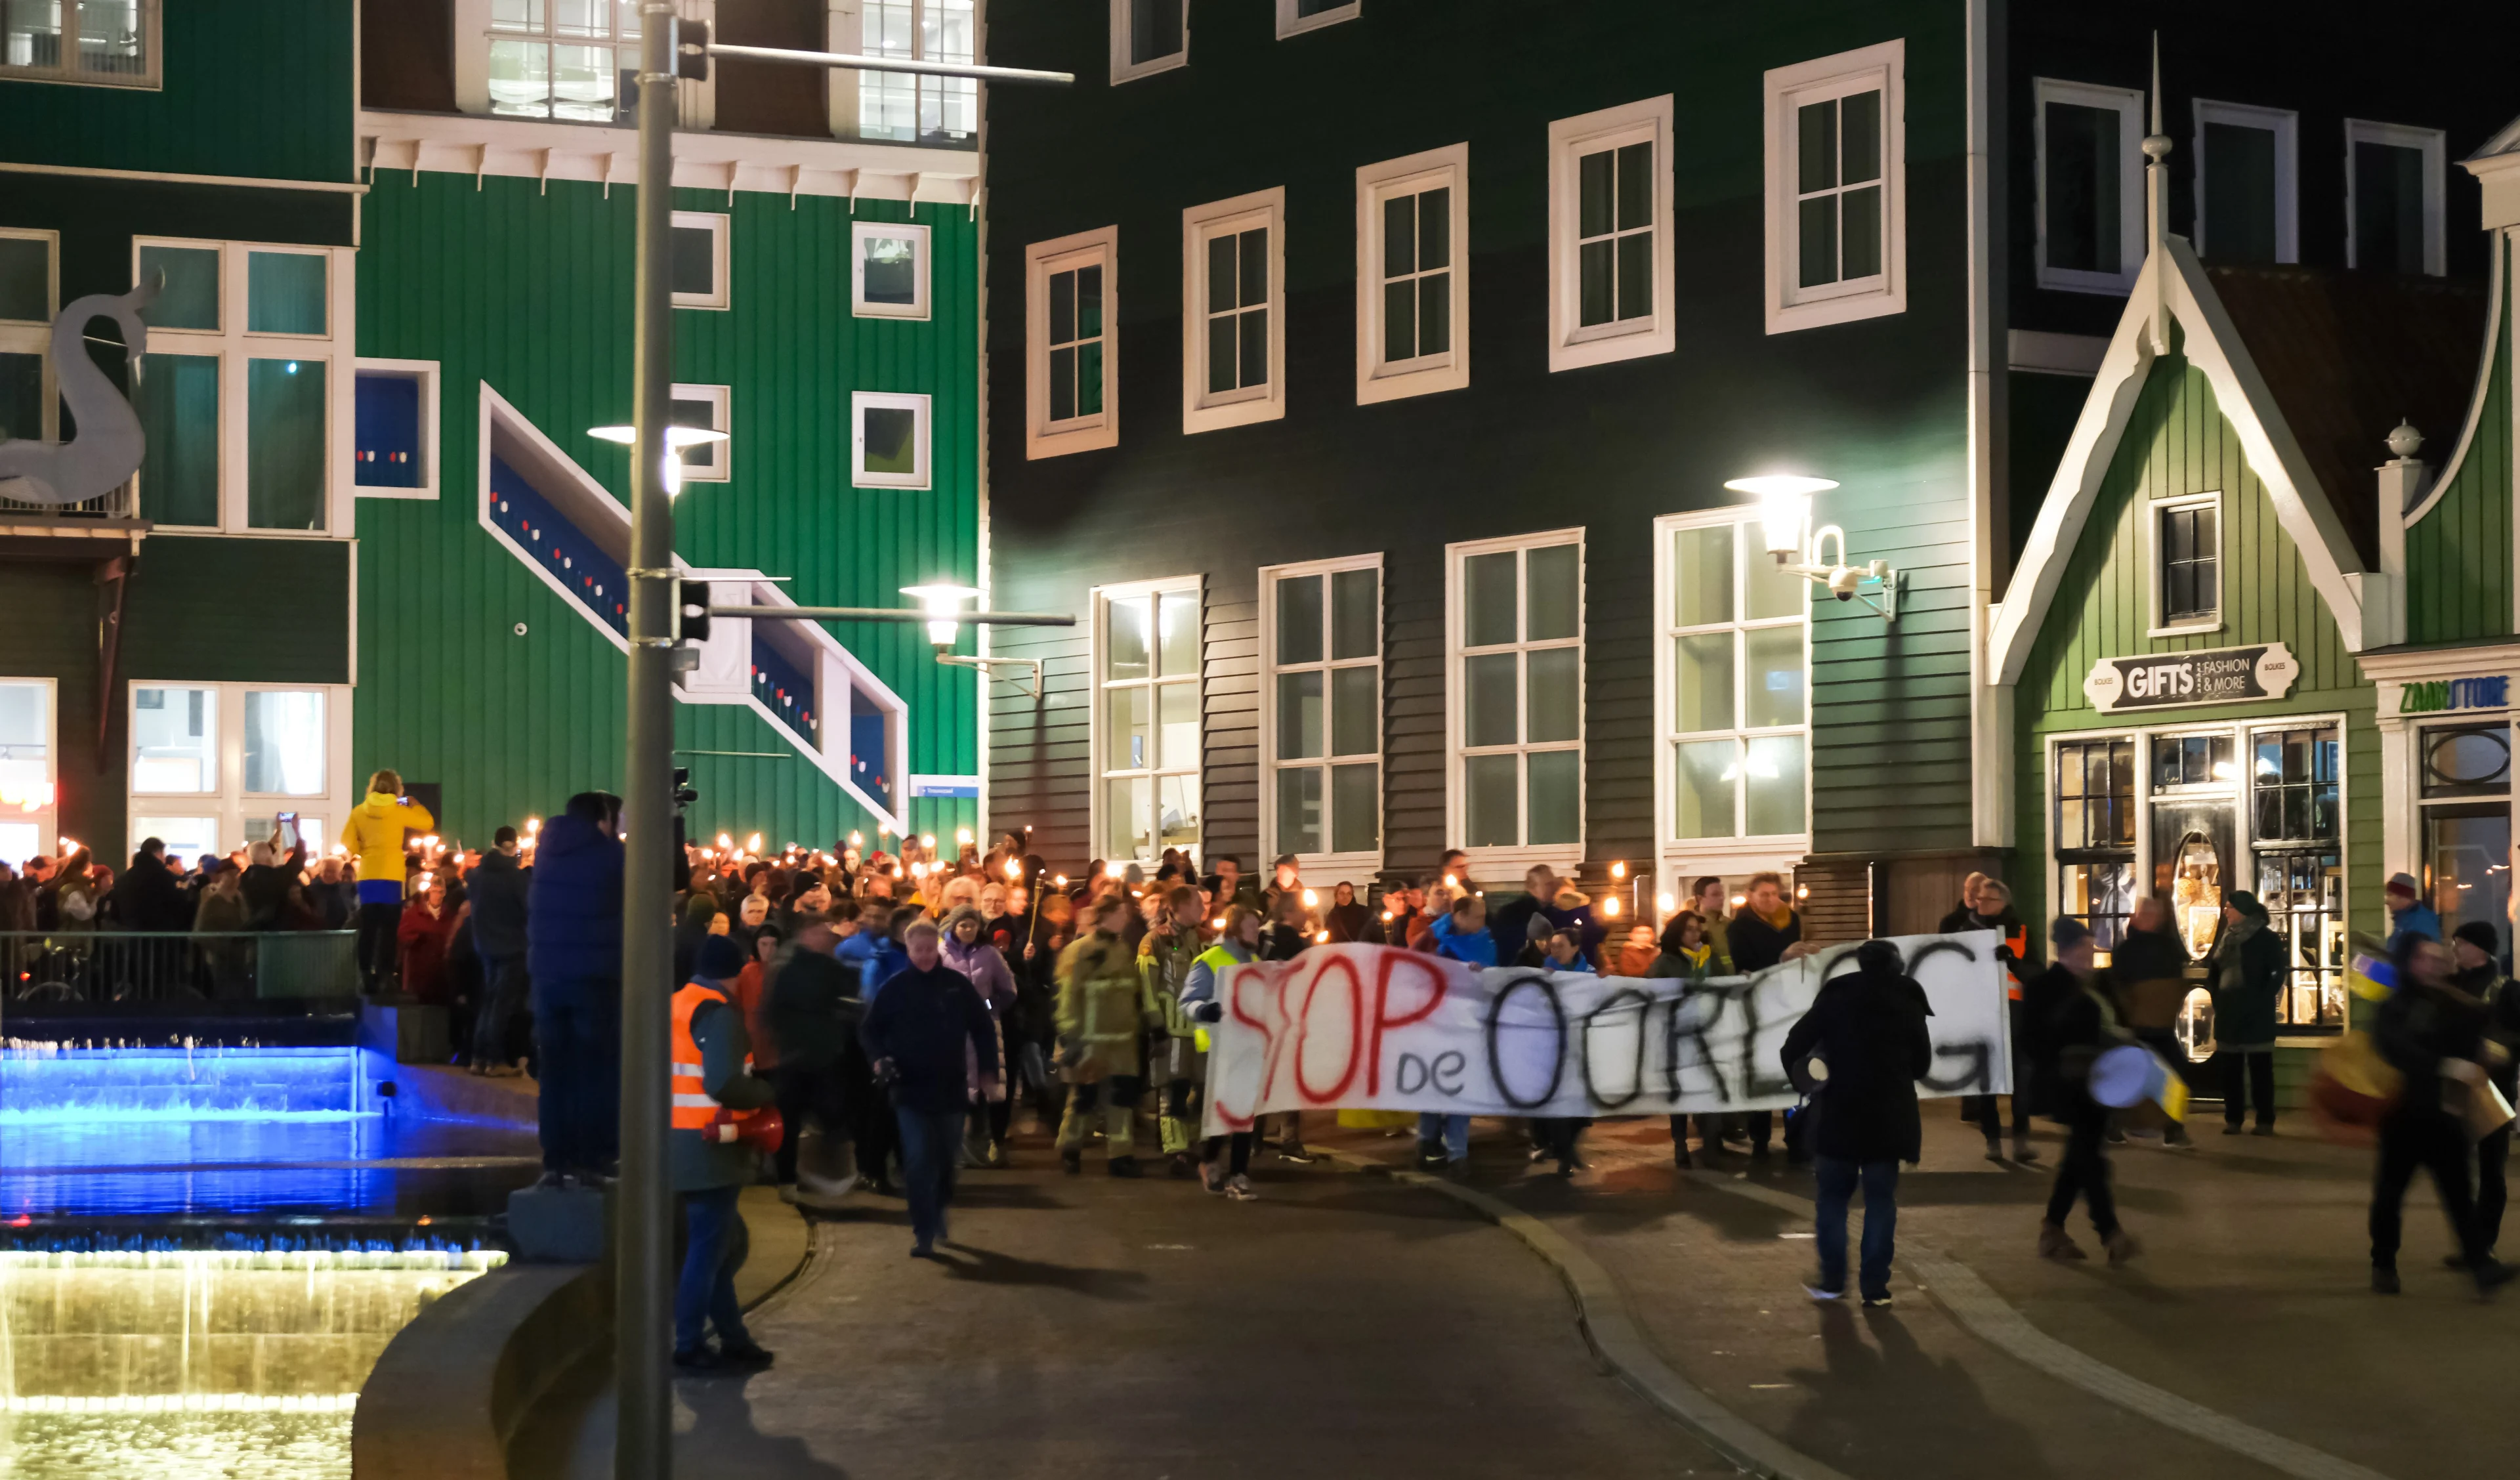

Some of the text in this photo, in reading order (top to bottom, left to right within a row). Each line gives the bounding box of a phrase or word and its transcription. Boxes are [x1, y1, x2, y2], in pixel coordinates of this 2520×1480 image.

[2204, 658, 2250, 675] FASHION
[2128, 663, 2194, 698] GIFTS
[2204, 676, 2245, 691] & MORE
[1215, 949, 1447, 1127] STOP
[1488, 941, 1996, 1109] OORLG
